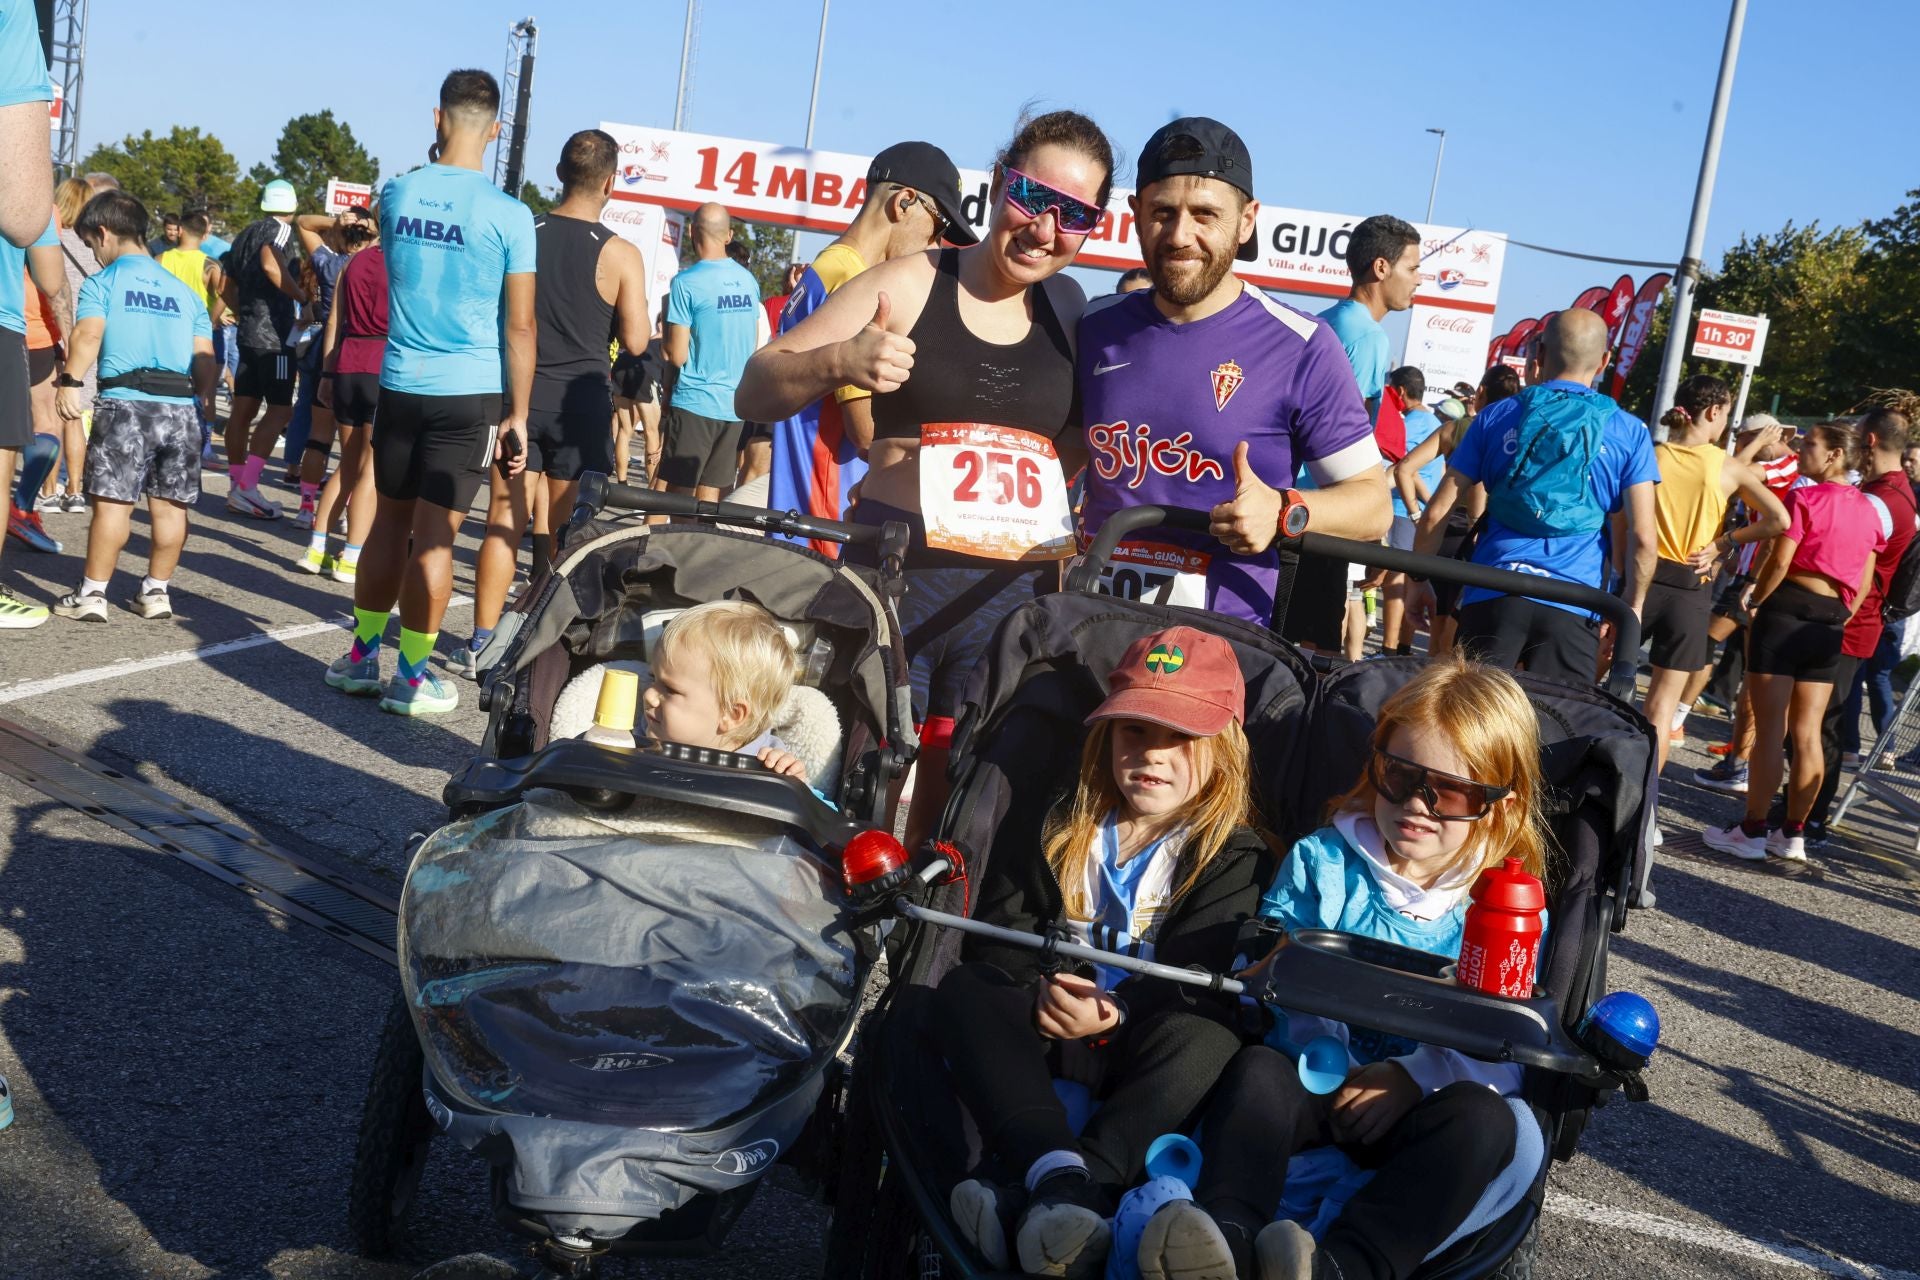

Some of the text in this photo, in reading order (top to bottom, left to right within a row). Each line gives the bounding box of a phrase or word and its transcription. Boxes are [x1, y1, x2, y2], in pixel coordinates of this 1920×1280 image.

[695, 147, 867, 209] 14 MBA
[335, 193, 348, 205] 1h
[395, 215, 465, 246] MBA
[394, 235, 465, 254] SURGICAL EMPOWERMENT
[1267, 258, 1295, 270] Villa
[1299, 262, 1314, 273] de
[125, 290, 181, 313] MBA
[717, 294, 752, 310] MBA
[1616, 300, 1654, 379] MBA
[1702, 326, 1722, 343] 1h
[952, 450, 1043, 509] 256
[1154, 551, 1185, 565] GIJÓN
[1467, 944, 1483, 988] GIJÓN
